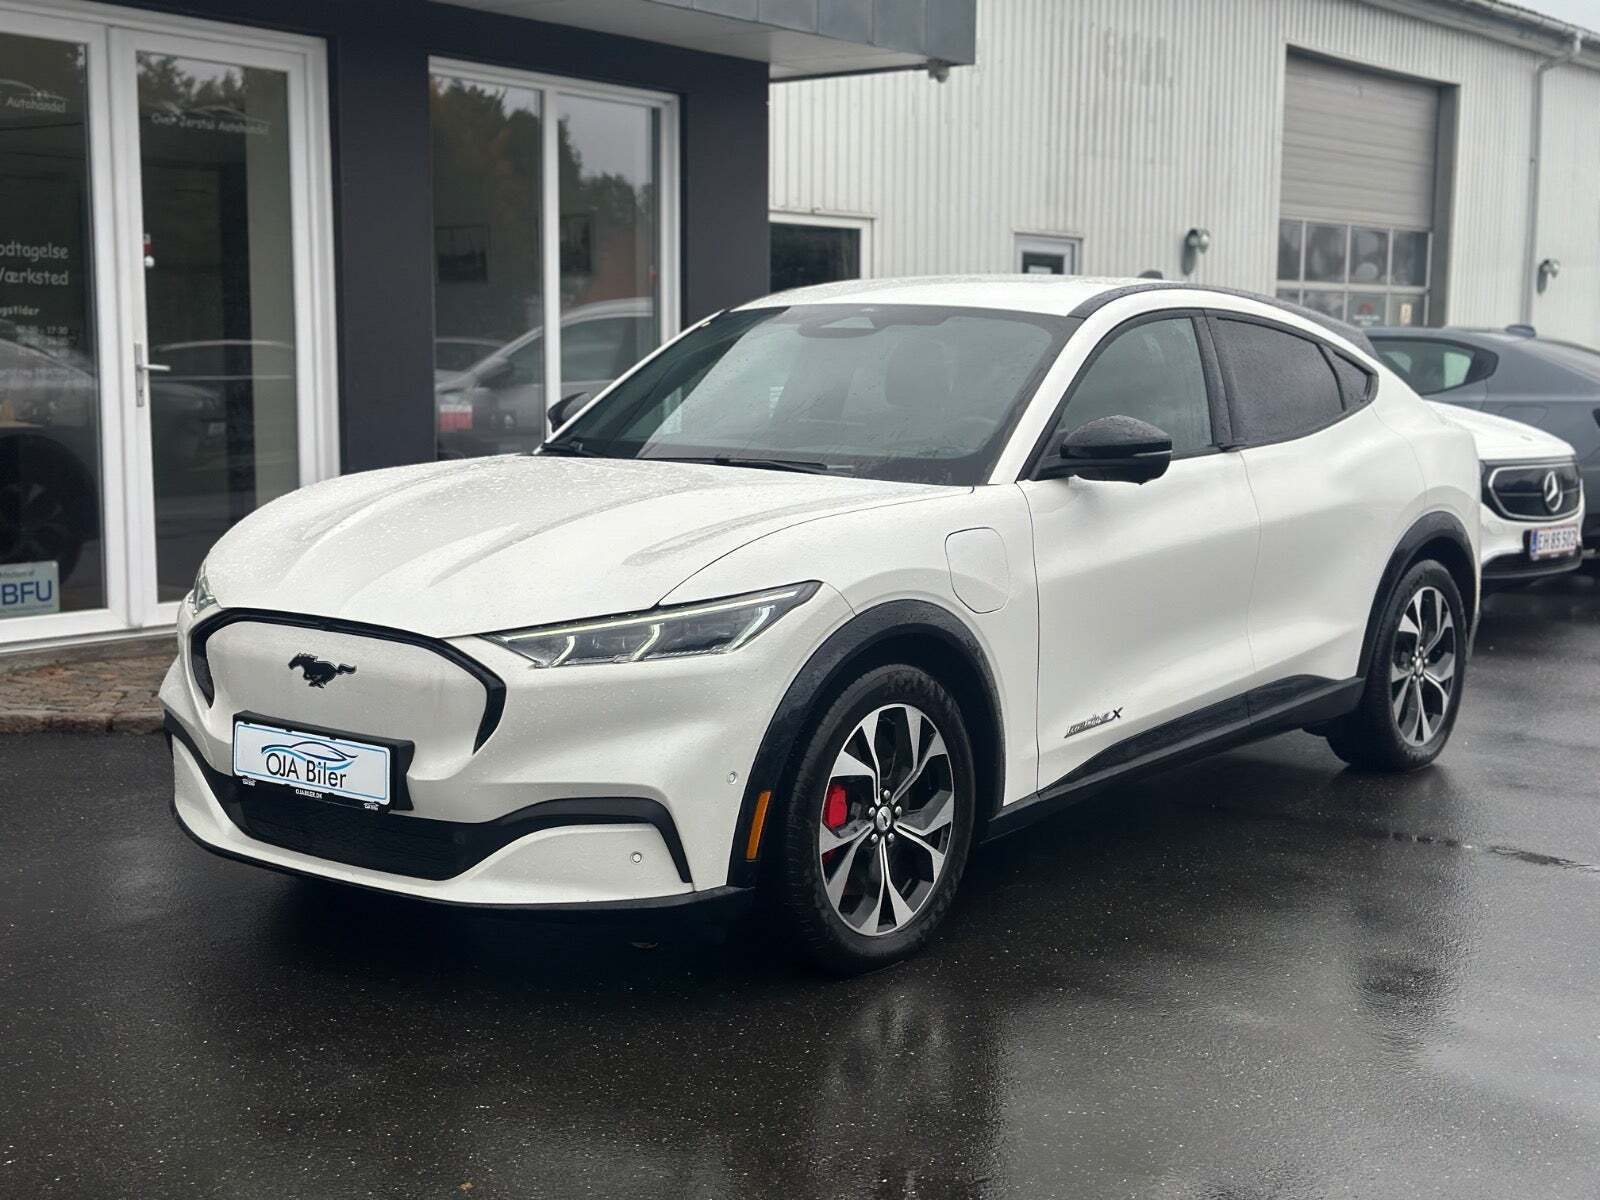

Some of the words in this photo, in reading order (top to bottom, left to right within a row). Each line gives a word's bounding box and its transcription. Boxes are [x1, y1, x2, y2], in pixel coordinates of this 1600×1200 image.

[2, 580, 52, 605] BFU
[266, 752, 300, 779] OJA
[306, 760, 347, 788] Biler
